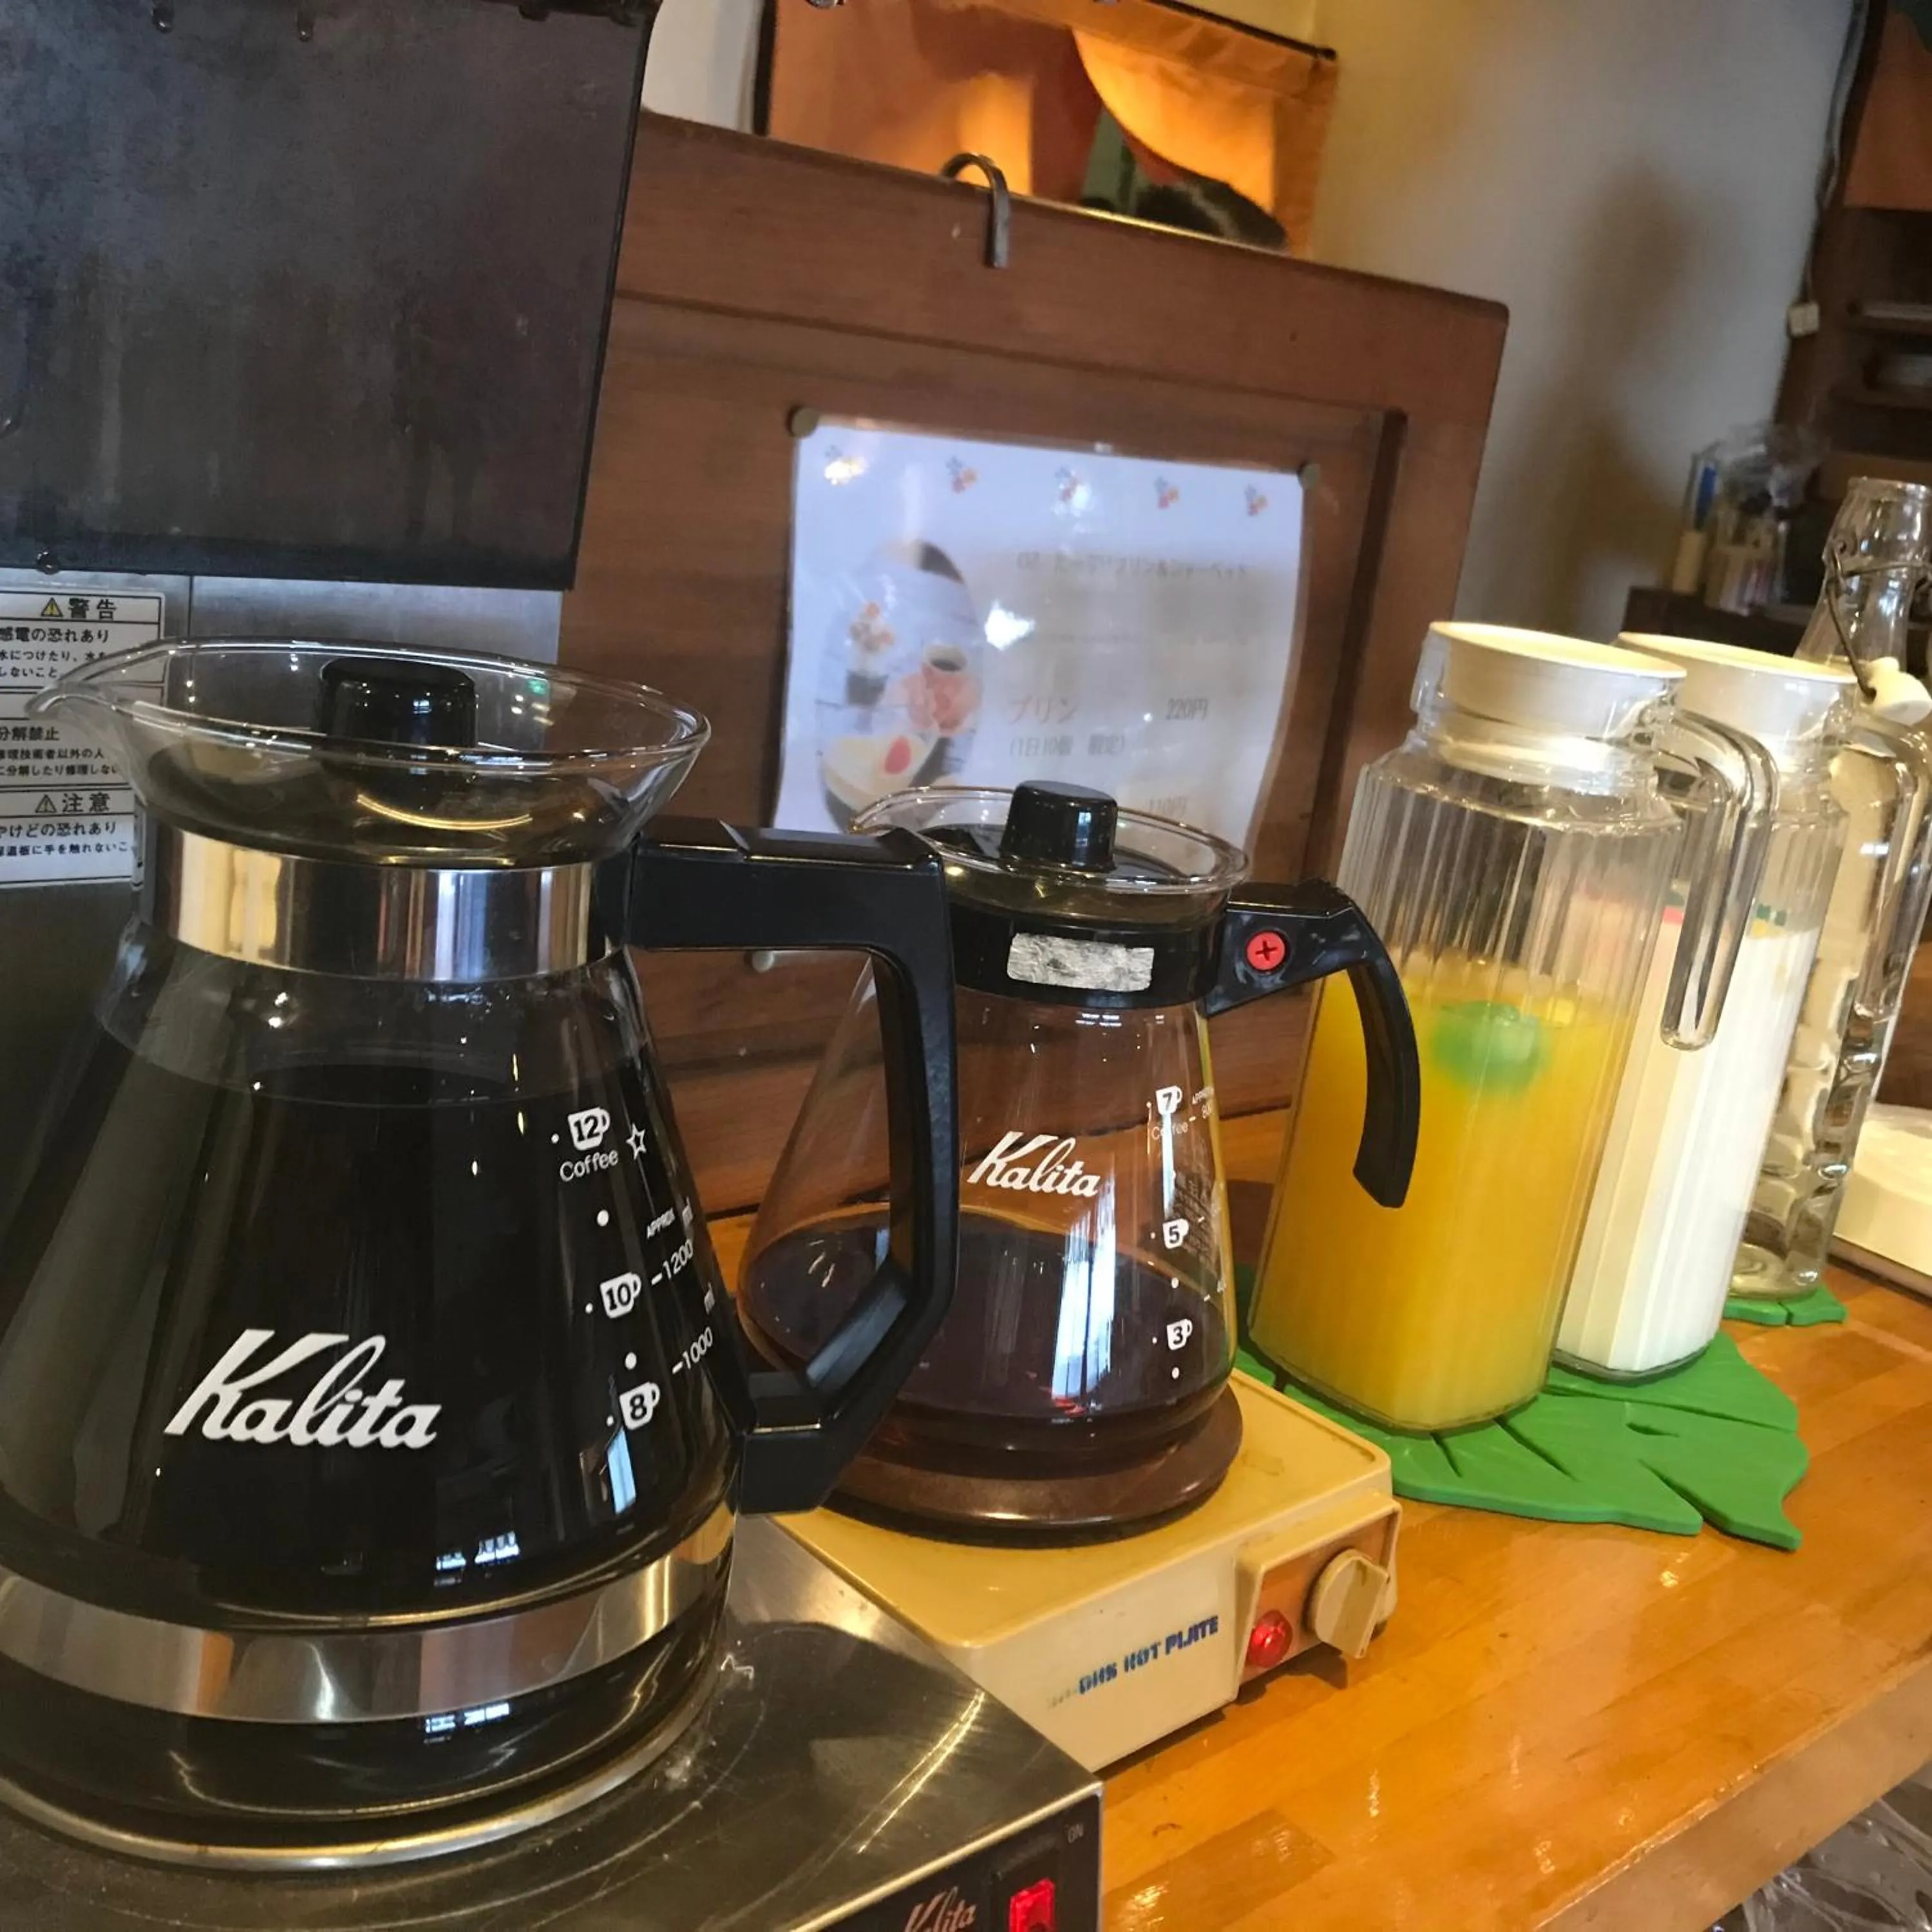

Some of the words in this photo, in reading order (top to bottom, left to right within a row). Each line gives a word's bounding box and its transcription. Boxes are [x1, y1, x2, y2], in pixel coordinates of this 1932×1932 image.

[68, 598, 117, 620] 警告
[0, 627, 109, 643] 感電の恐れあり
[0, 726, 60, 741] 分解禁止
[62, 792, 111, 813] 注意
[574, 1115, 600, 1142] 12
[560, 1150, 619, 1182] Coffee
[967, 1130, 1101, 1198] Kalita
[605, 1282, 631, 1311] 10
[164, 1329, 442, 1449] Kalita
[904, 1886, 978, 1932] Klita
